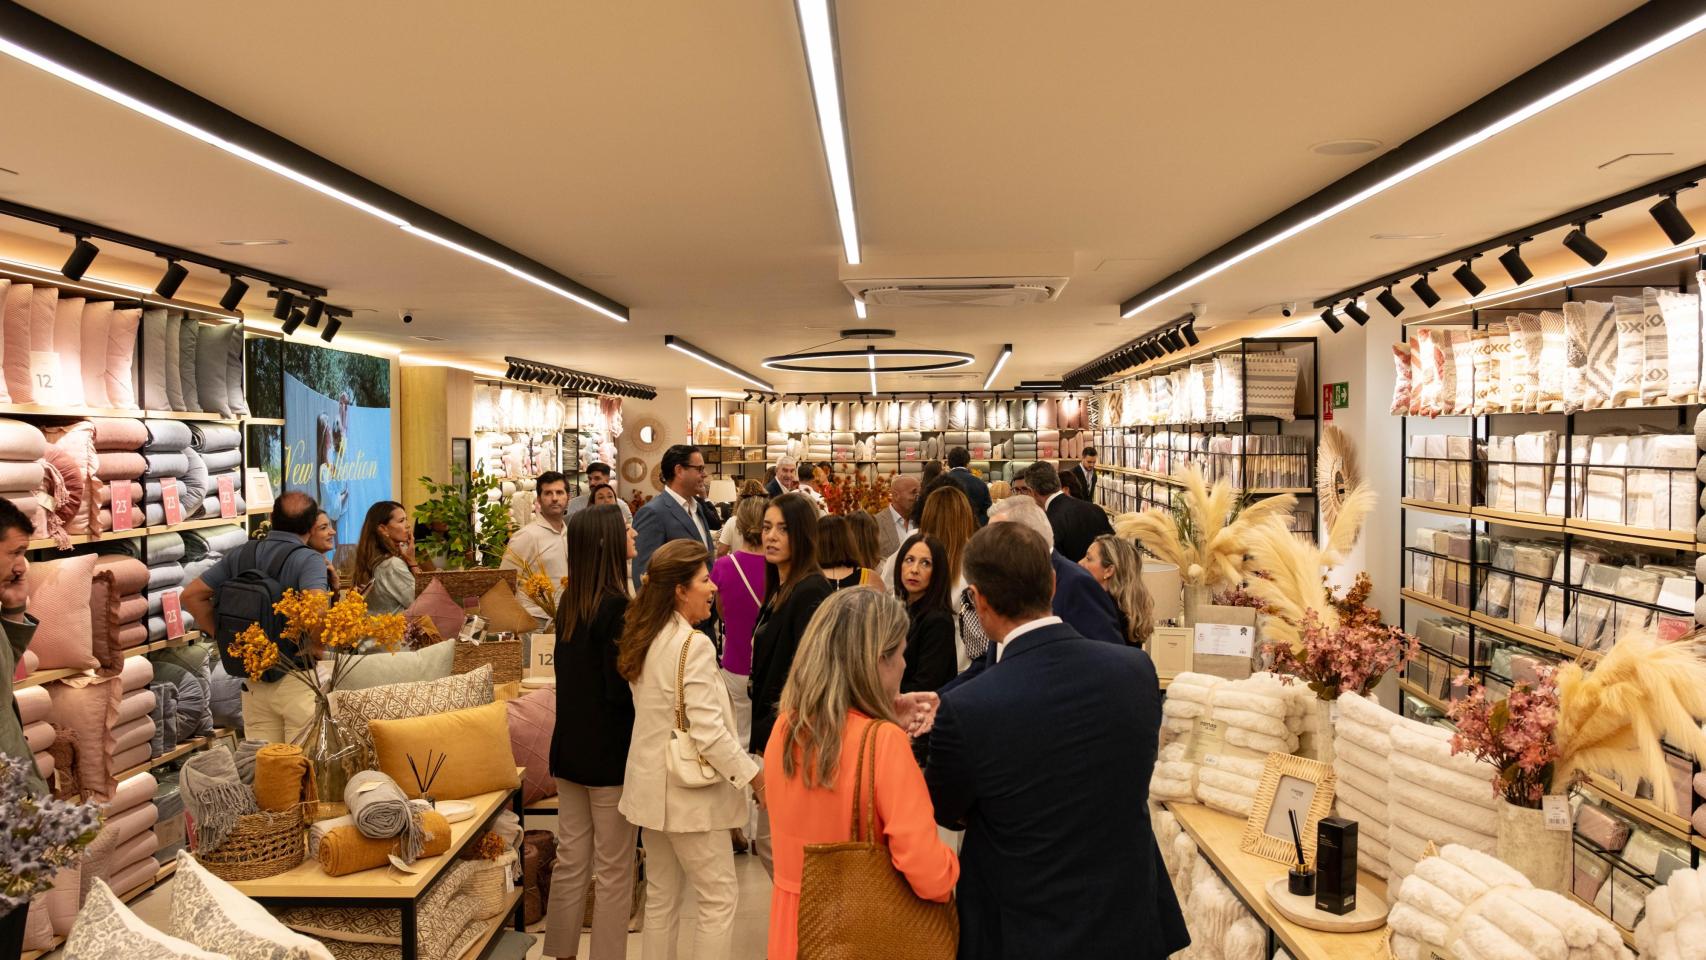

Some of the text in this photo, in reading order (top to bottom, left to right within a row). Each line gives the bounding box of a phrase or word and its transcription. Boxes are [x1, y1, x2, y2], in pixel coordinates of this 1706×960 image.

[36, 374, 53, 388] 12
[273, 438, 378, 486] New collection
[166, 497, 176, 509] 23
[222, 491, 231, 503] 23
[116, 500, 127, 513] 23
[166, 609, 178, 624] 23
[538, 653, 553, 666] 12
